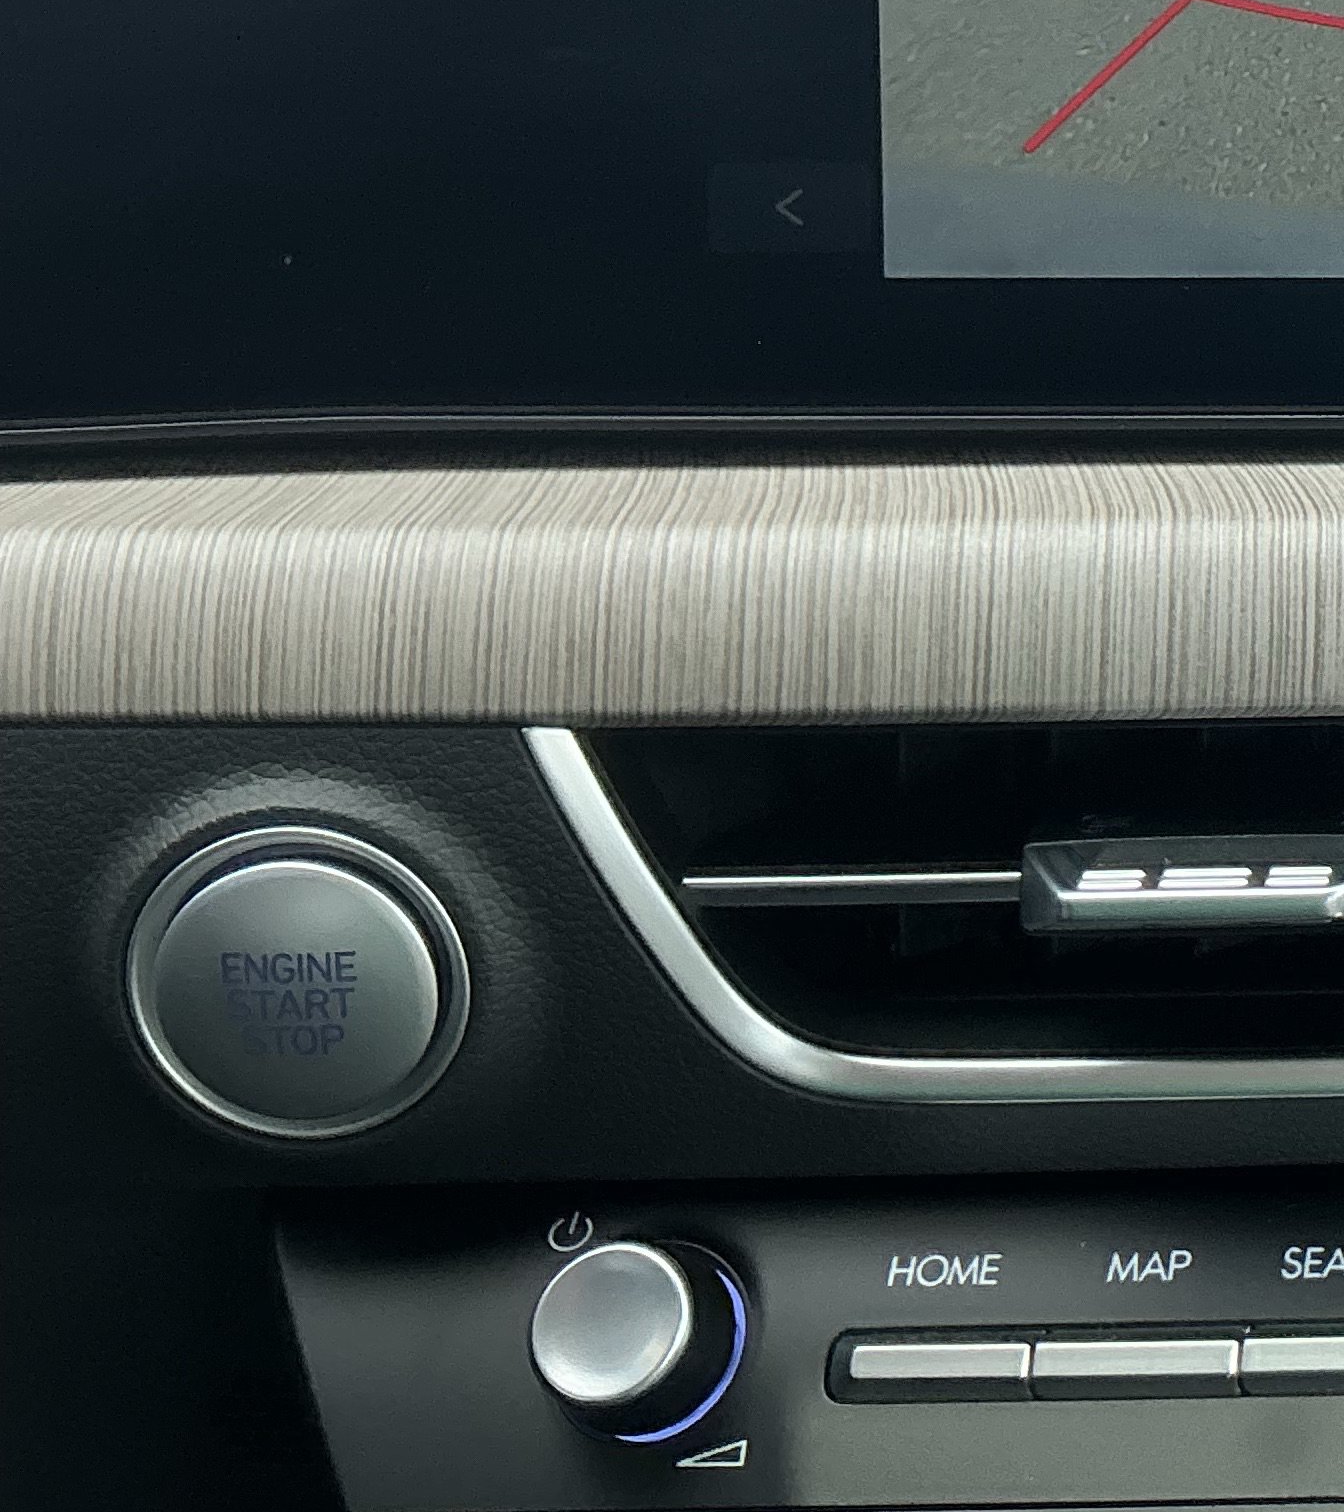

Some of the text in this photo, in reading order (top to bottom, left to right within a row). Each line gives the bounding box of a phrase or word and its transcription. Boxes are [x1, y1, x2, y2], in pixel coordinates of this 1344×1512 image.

[220, 950, 357, 984] ENGINE
[227, 988, 354, 1020] START
[245, 1024, 345, 1056] STOP
[886, 1254, 1002, 1288] HOME
[1105, 1250, 1193, 1284] MAP
